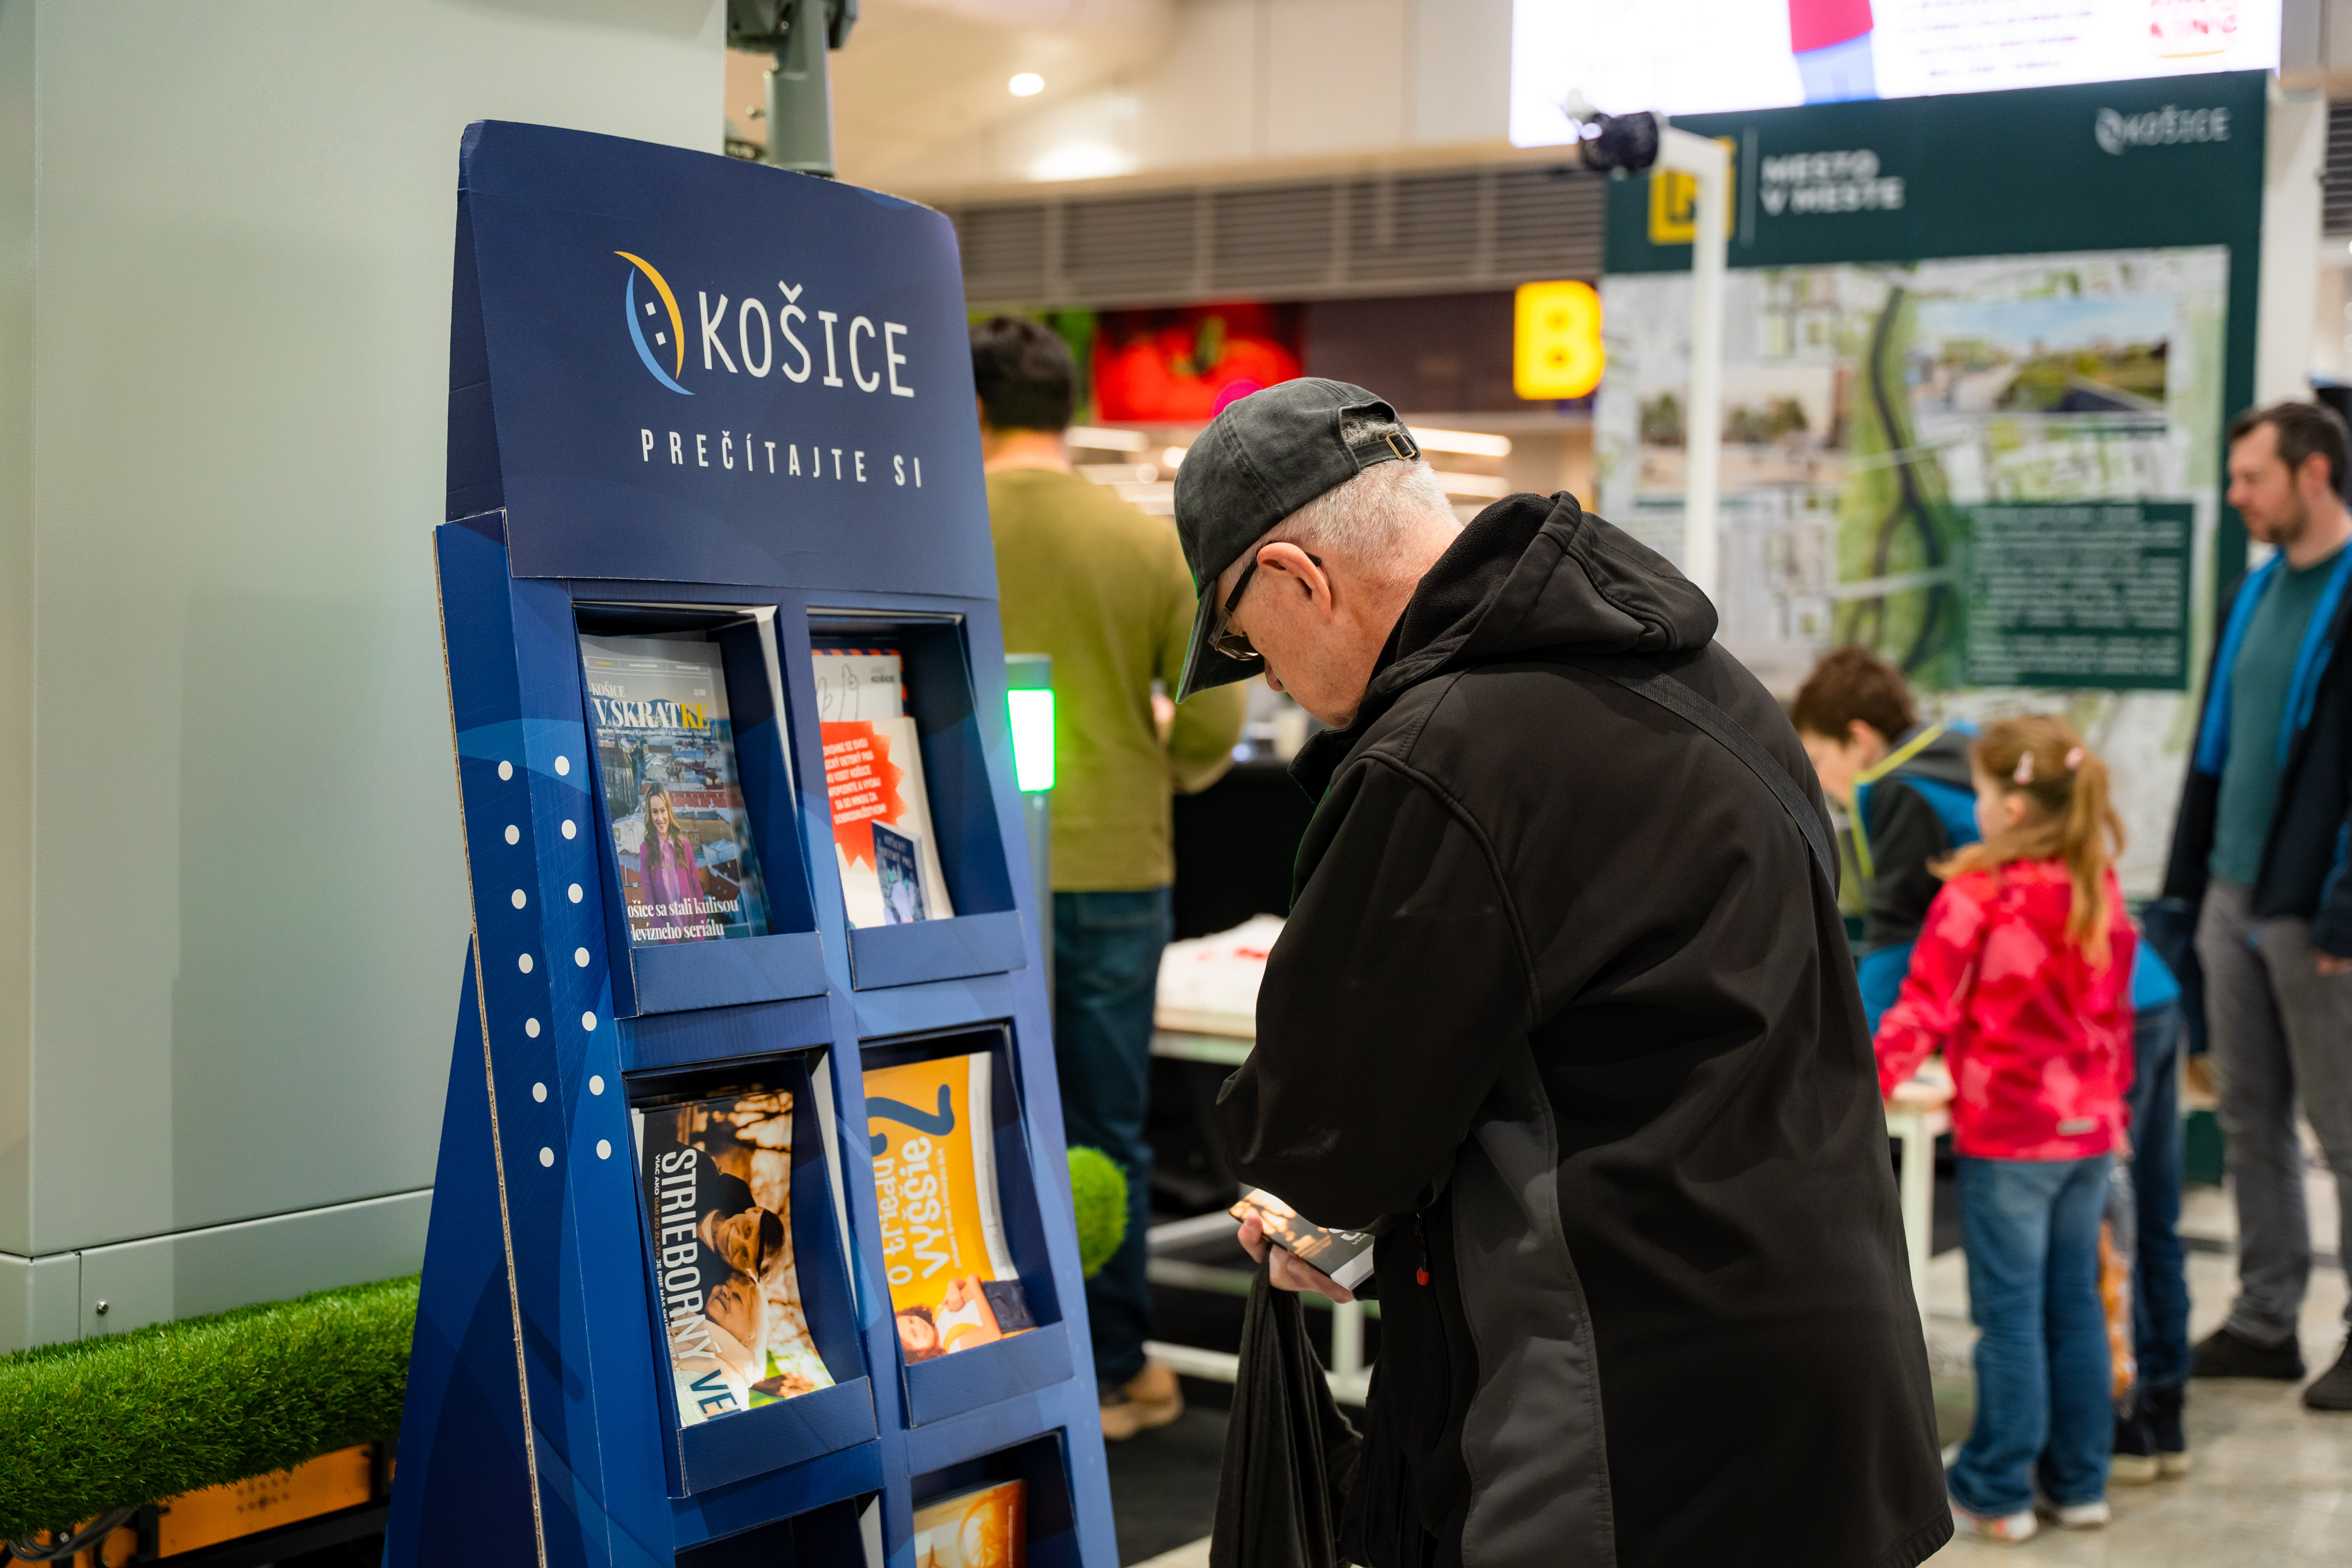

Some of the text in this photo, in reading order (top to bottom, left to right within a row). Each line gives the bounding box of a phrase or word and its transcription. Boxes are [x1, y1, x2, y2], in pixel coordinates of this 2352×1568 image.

[698, 280, 915, 398] KOŠICE
[1513, 280, 1604, 401] B
[641, 428, 922, 488] PREČÍTAJTE SI
[592, 681, 625, 698] KOŠICE
[592, 699, 710, 730] V SKRATKE
[627, 897, 739, 918] ošice sa stali kulisou
[631, 919, 724, 941] levízneho seriálu
[873, 1157, 906, 1256] triedu
[899, 1136, 950, 1279] vyššie
[654, 1217, 659, 1229] ZO
[656, 1259, 662, 1269] JE
[661, 1149, 722, 1359] STRIEBORNÝ
[675, 1367, 688, 1391] RADA
[686, 1392, 694, 1404] OD
